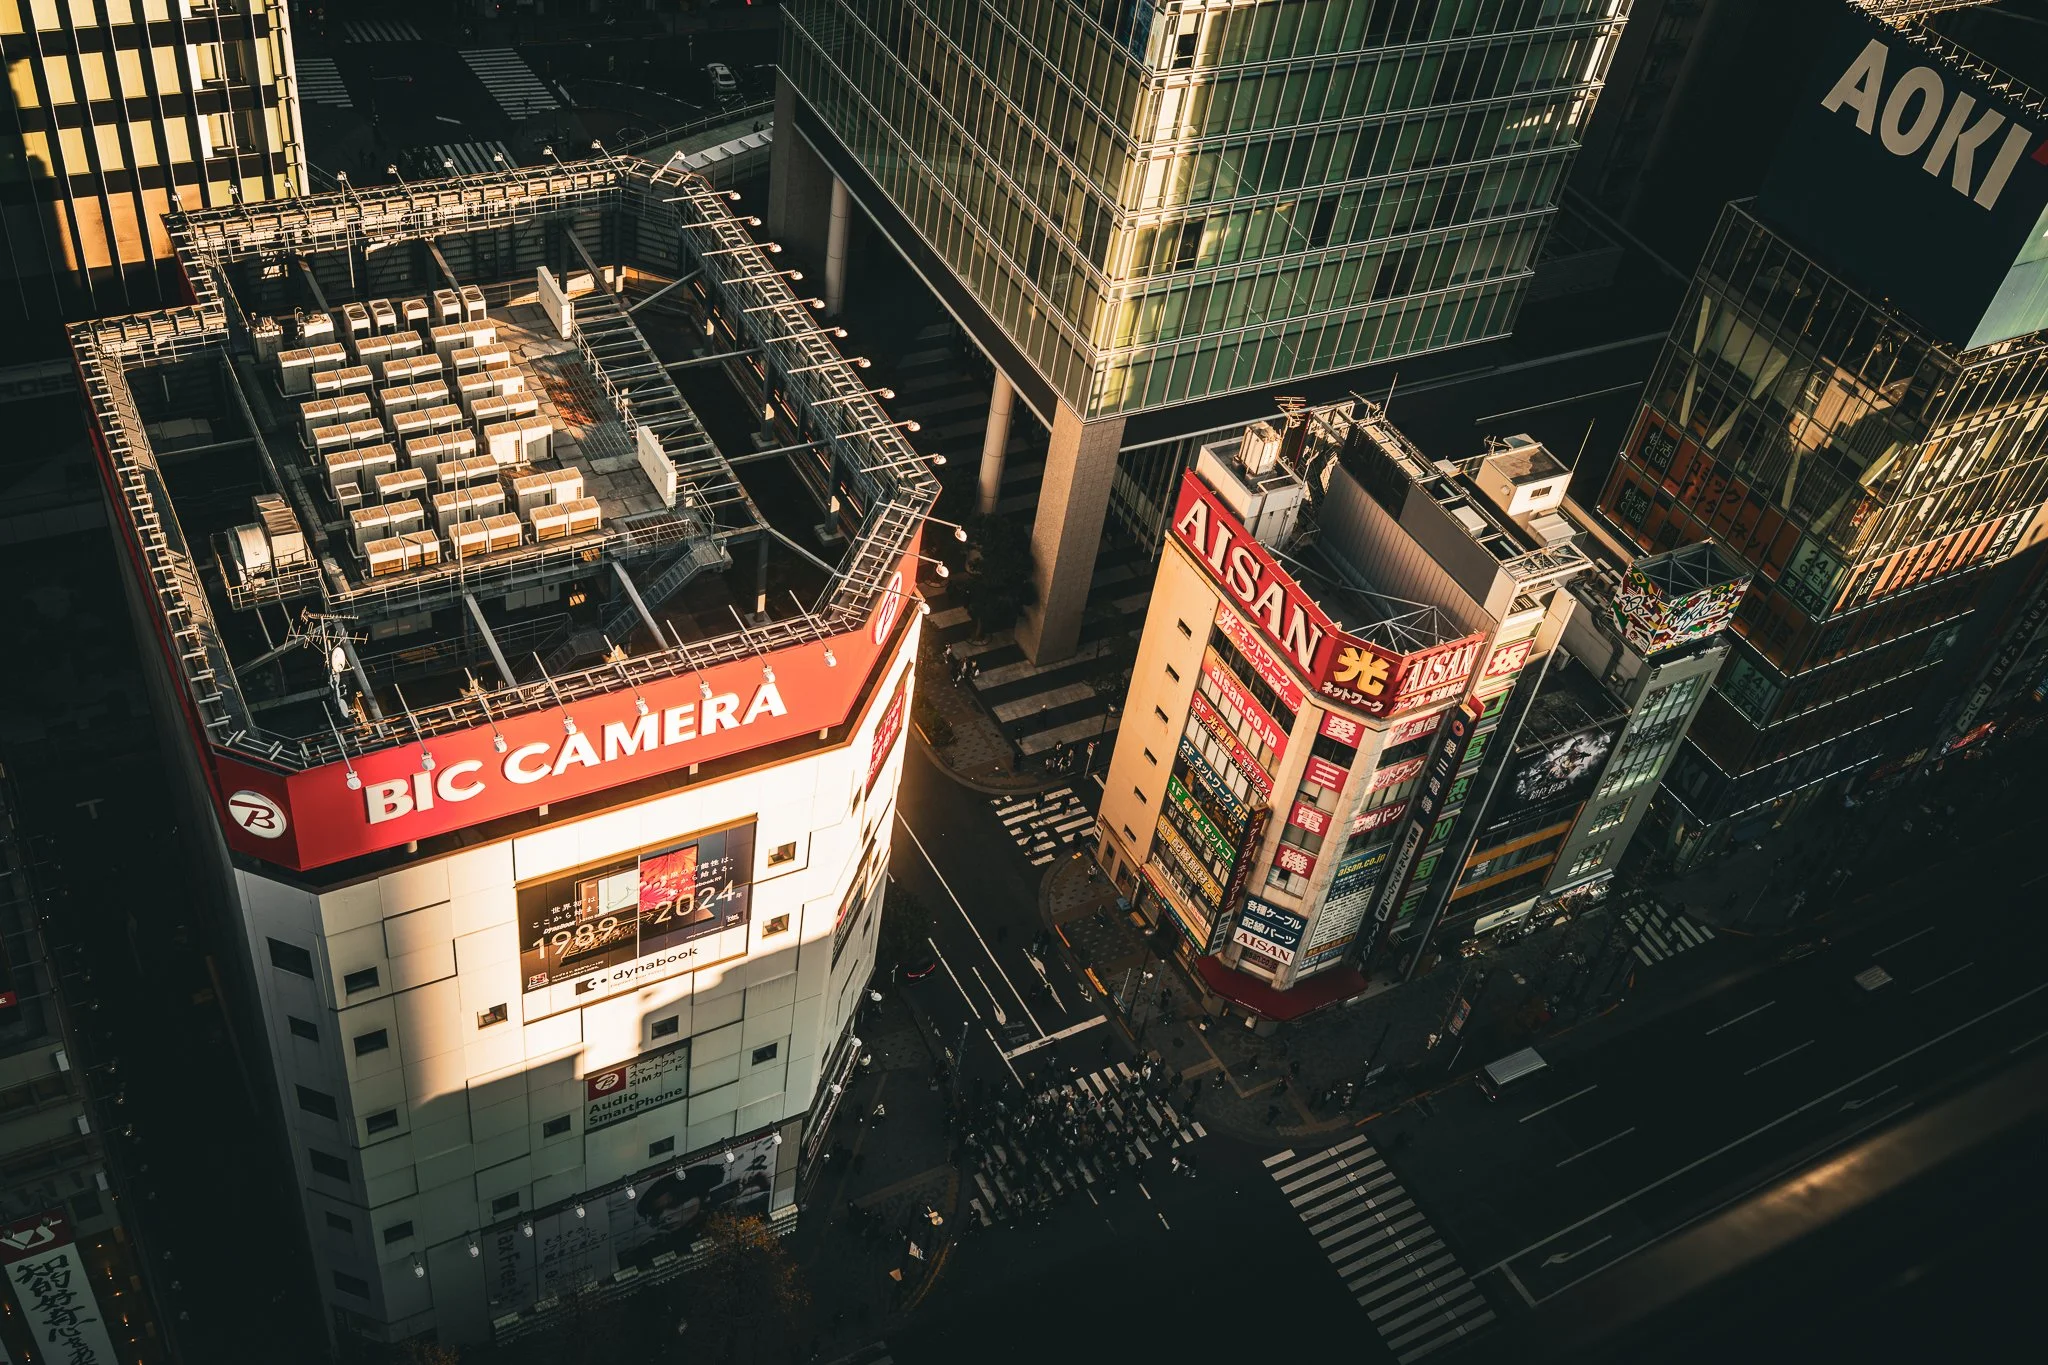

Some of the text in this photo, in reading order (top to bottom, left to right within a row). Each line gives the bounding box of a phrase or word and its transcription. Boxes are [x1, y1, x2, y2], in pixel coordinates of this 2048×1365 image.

[1820, 38, 2033, 211] AOKI
[1645, 447, 1666, 469] CUB
[1620, 501, 1642, 523] CUB
[1177, 498, 1322, 674] AISAN
[1333, 647, 1390, 697] 光
[1400, 641, 1481, 695] AISAN
[1194, 697, 1207, 714] 3F
[1211, 665, 1278, 748] aisan.co.jp
[1321, 681, 1384, 713] ネットワーク
[1389, 715, 1441, 745] 光通信
[365, 758, 487, 825] BIC
[501, 682, 789, 785] CAMERA
[1171, 781, 1183, 797] 1F
[1181, 739, 1195, 756] 2F
[1194, 756, 1249, 822] ネットワーク・RF
[1241, 758, 1271, 794] セキュリティ
[1281, 715, 1357, 876] 愛三電機
[1337, 853, 1387, 877] aisan.co.jp
[1241, 916, 1296, 945] 配線パーツ
[1247, 899, 1302, 930] 各種ケーブル
[532, 916, 618, 960] 1989
[1237, 932, 1291, 962] AISAN
[613, 947, 699, 980] dynabook
[629, 1055, 685, 1079] スマートフォン
[629, 1064, 683, 1088] SIMカード
[589, 1092, 640, 1115] Audio
[589, 1087, 683, 1126] SmartPhone
